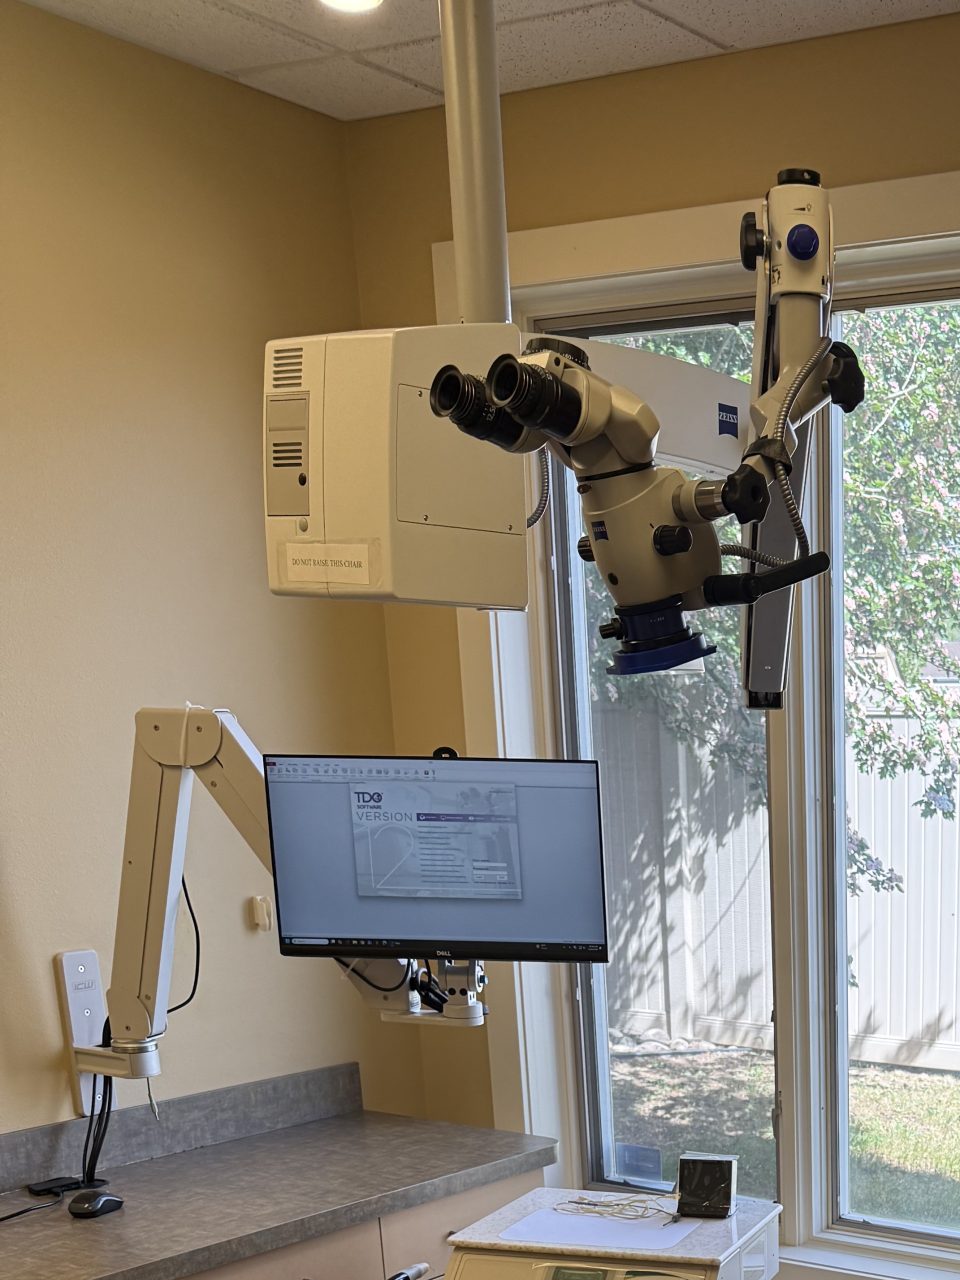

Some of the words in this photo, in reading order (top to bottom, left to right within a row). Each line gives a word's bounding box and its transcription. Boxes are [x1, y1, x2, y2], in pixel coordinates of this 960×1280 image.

[719, 411, 738, 424] ZEISS
[292, 558, 300, 566] DO
[300, 558, 312, 567] NOT
[312, 559, 329, 567] RAISE
[330, 559, 343, 568] THIS
[343, 560, 363, 569] CHAIR
[356, 811, 413, 822] VERSION
